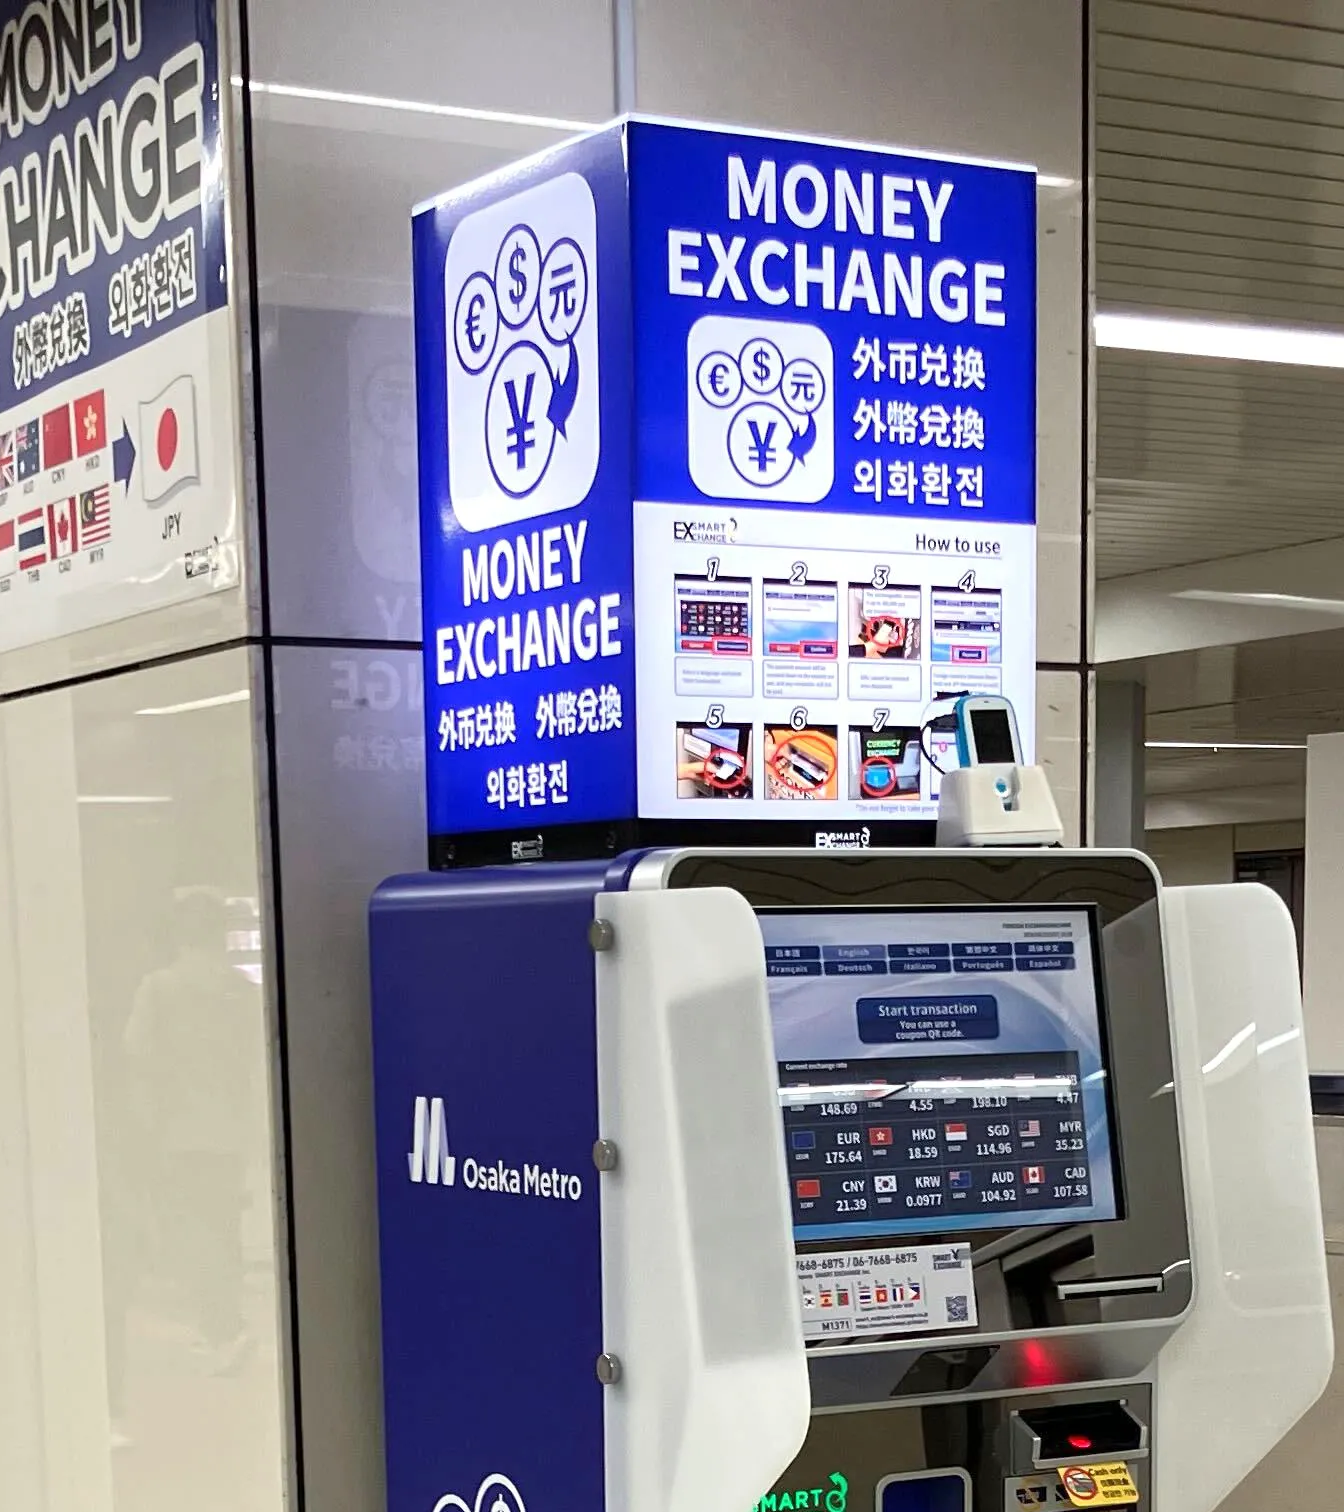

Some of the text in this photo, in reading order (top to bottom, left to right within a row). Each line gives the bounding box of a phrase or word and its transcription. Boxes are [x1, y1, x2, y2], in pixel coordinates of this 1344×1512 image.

[728, 154, 954, 243] MONEY
[111, 231, 195, 335] 외화환전
[667, 227, 1006, 327] EXCHANGE
[852, 336, 986, 391] 外币兑换
[852, 459, 984, 508] 외화환전
[162, 512, 181, 539] JPY
[693, 523, 726, 531] SMART
[916, 533, 1001, 554] How to use
[463, 520, 588, 607] MONEY
[791, 562, 807, 585] 2
[873, 566, 889, 588] 3
[959, 571, 974, 592] 4
[436, 592, 622, 685] EXCHANGE
[707, 705, 723, 727] 5
[791, 707, 807, 729] 6
[873, 709, 888, 731] 7
[438, 701, 516, 751] 外币兑换
[486, 760, 568, 810] 외화환전
[830, 832, 860, 841] SMART
[838, 948, 869, 958] English
[770, 965, 808, 974] Français
[838, 964, 872, 972] Deutsch
[903, 963, 937, 971] Italiano
[962, 961, 1004, 971] Português
[1029, 960, 1061, 970] Español
[879, 1004, 977, 1017] Start transaction
[900, 1020, 956, 1030] You can use a
[896, 1031, 927, 1041] coupon
[928, 1030, 941, 1040] QR
[809, 1063, 835, 1072] exchange
[972, 1097, 1007, 1108] 198.10
[1056, 1093, 1079, 1104] 4.47
[820, 1103, 858, 1116] 148.69
[909, 1100, 934, 1111] 4.55
[987, 1124, 1010, 1137] SGD
[1059, 1121, 1082, 1133] MYR
[837, 1132, 861, 1145] EUR
[912, 1128, 936, 1141] HKD
[976, 1143, 1012, 1156] 114.96
[1055, 1139, 1084, 1151] 35.23
[825, 1151, 863, 1164] 175.64
[908, 1147, 938, 1159] 18.59
[463, 1158, 582, 1200] Osaka Metro
[991, 1172, 1014, 1184] AUD
[1065, 1167, 1086, 1179] CAD
[842, 1180, 865, 1193] CNY
[915, 1176, 941, 1188] KRW
[981, 1190, 1016, 1203] 104.92
[1054, 1185, 1088, 1198] 107.58
[836, 1199, 867, 1212] 21.39
[906, 1194, 942, 1207] 0.0977
[853, 1252, 917, 1266] 06-7668-6875
[822, 1321, 850, 1332] M1371
[1088, 1466, 1127, 1477] Cash only
